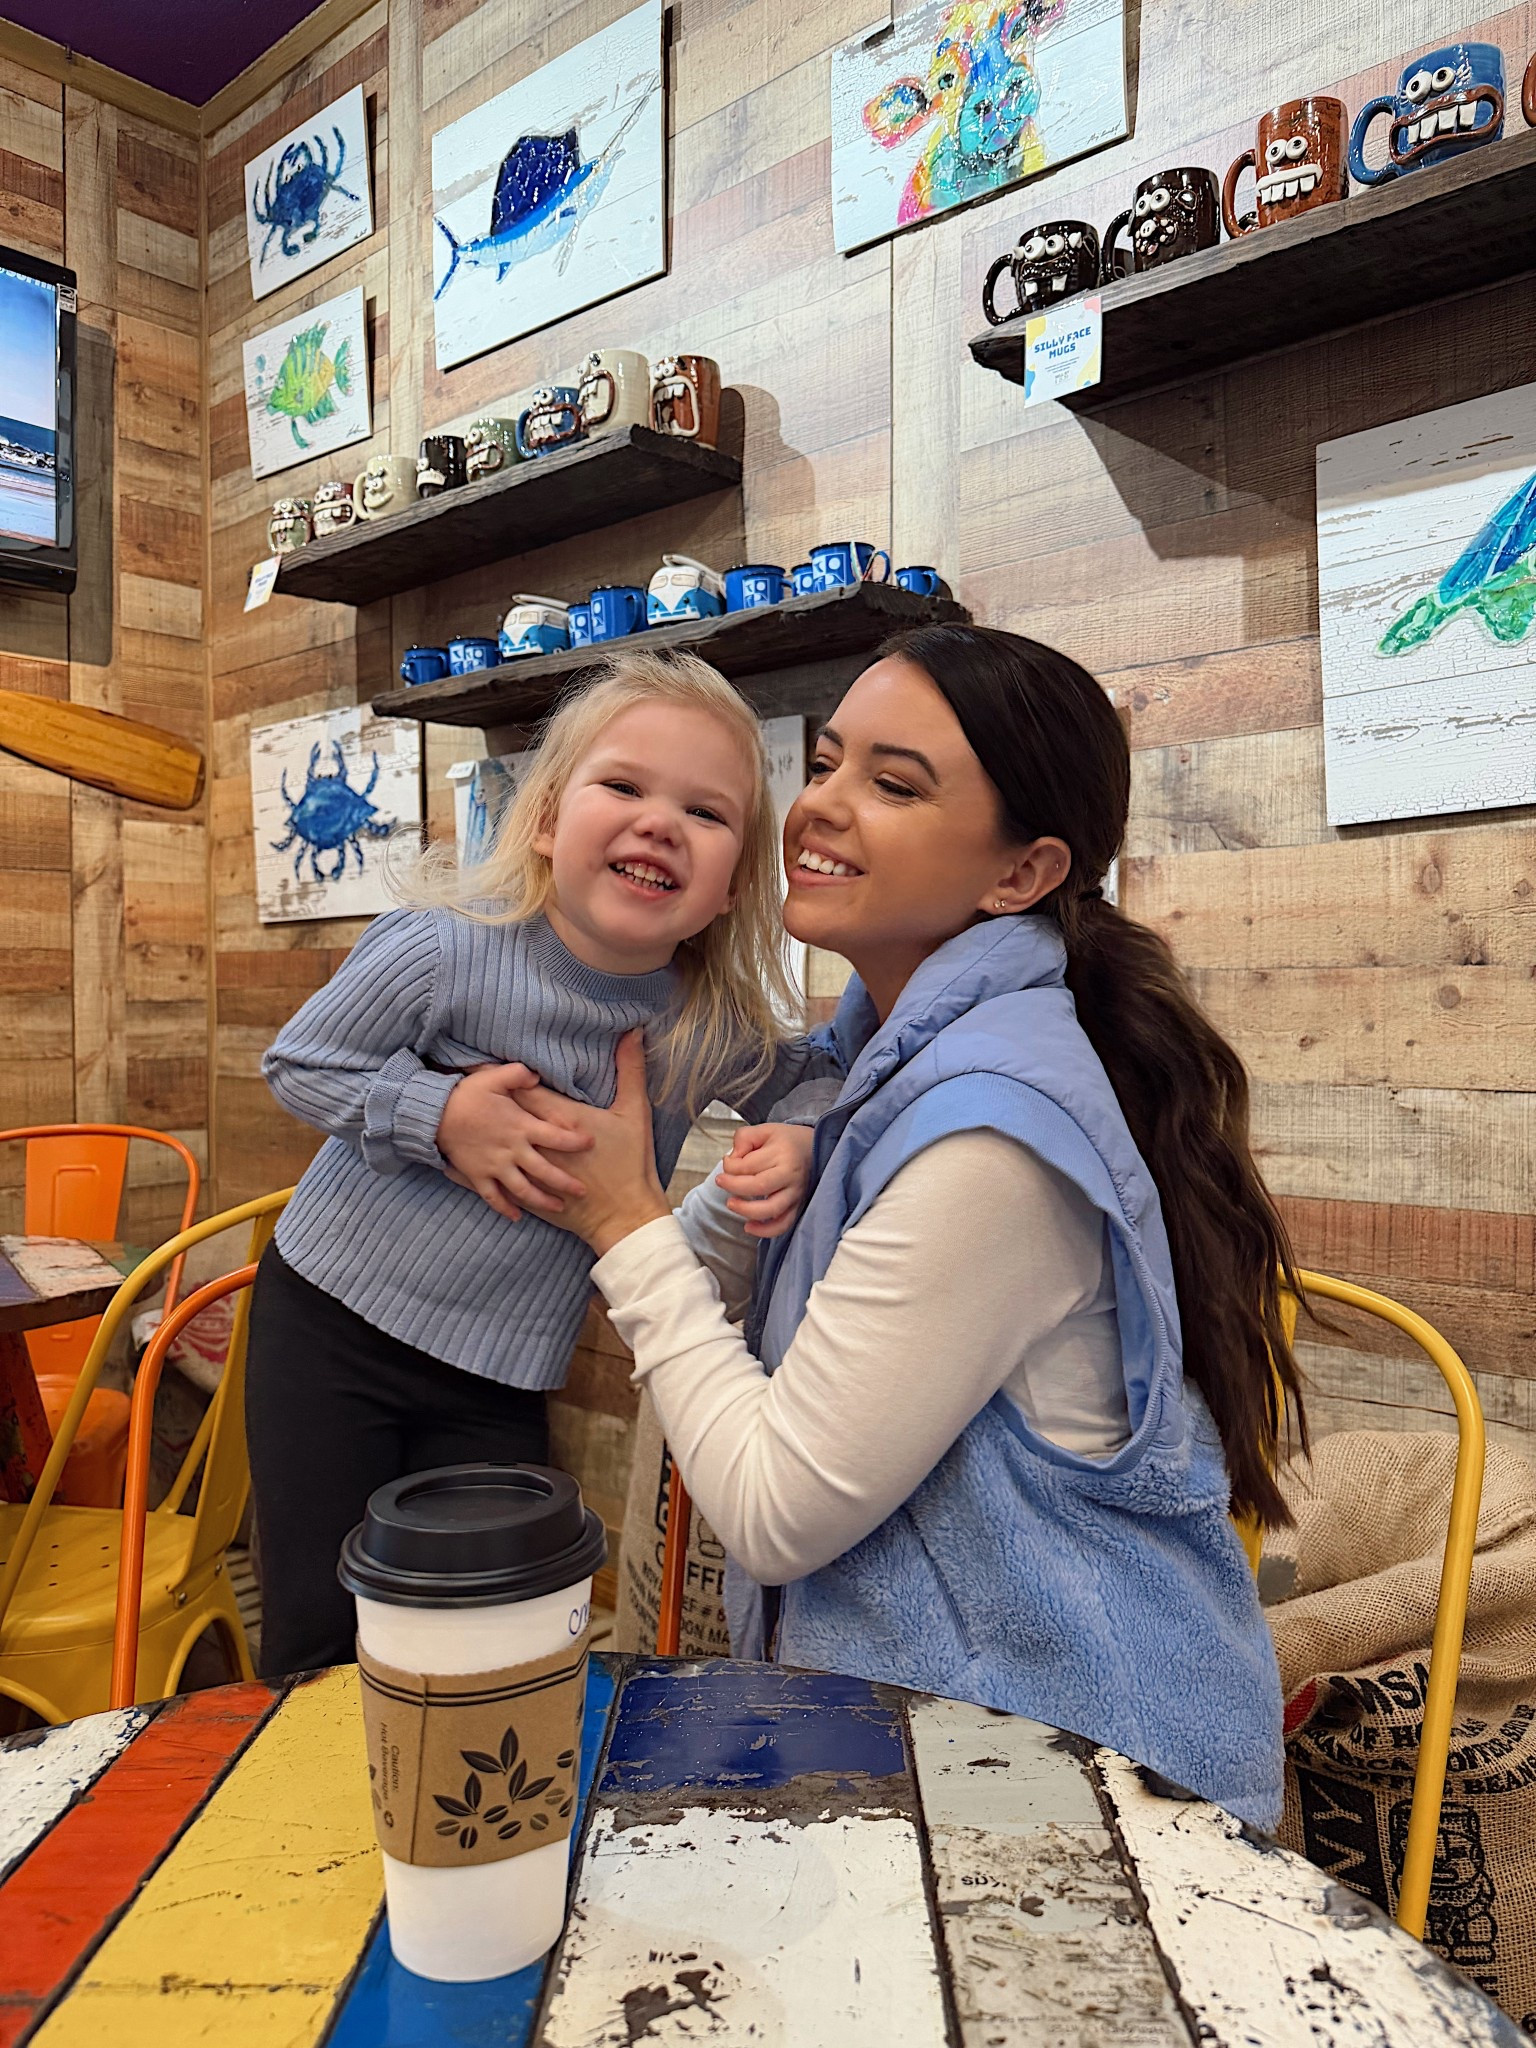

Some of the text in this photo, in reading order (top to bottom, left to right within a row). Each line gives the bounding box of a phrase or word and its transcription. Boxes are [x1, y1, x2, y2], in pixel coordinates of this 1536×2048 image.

[1034, 326, 1091, 354] SILLY FACE
[1049, 342, 1077, 358] MUGS
[380, 1721, 388, 1744] Hot
[391, 1745, 400, 1792] Caution:
